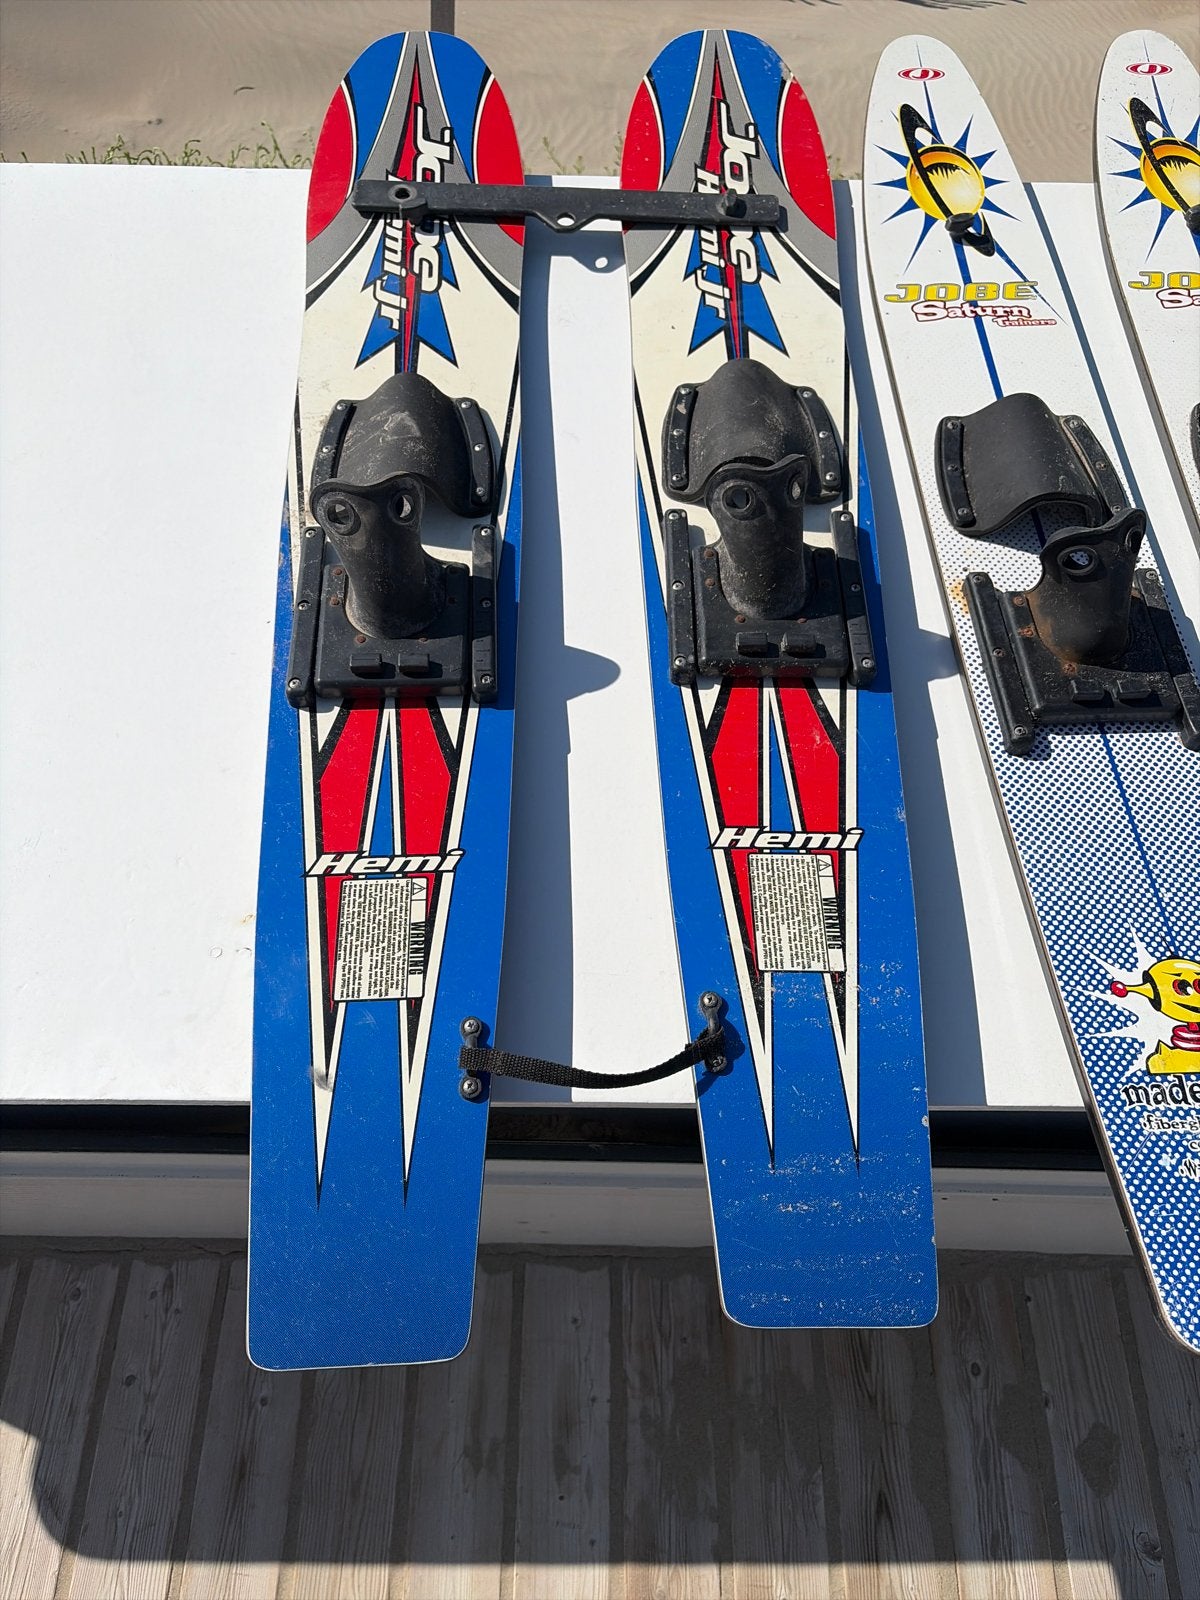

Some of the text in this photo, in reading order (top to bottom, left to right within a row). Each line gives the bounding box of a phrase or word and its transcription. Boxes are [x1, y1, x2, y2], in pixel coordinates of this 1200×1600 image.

[696, 166, 726, 268] Hmi
[884, 281, 1038, 302] JOBE
[911, 300, 1032, 322] Saturn
[712, 827, 864, 849] Hemi
[307, 849, 464, 876] Hemi
[822, 897, 842, 950] WARNING
[409, 921, 426, 975] WARNING
